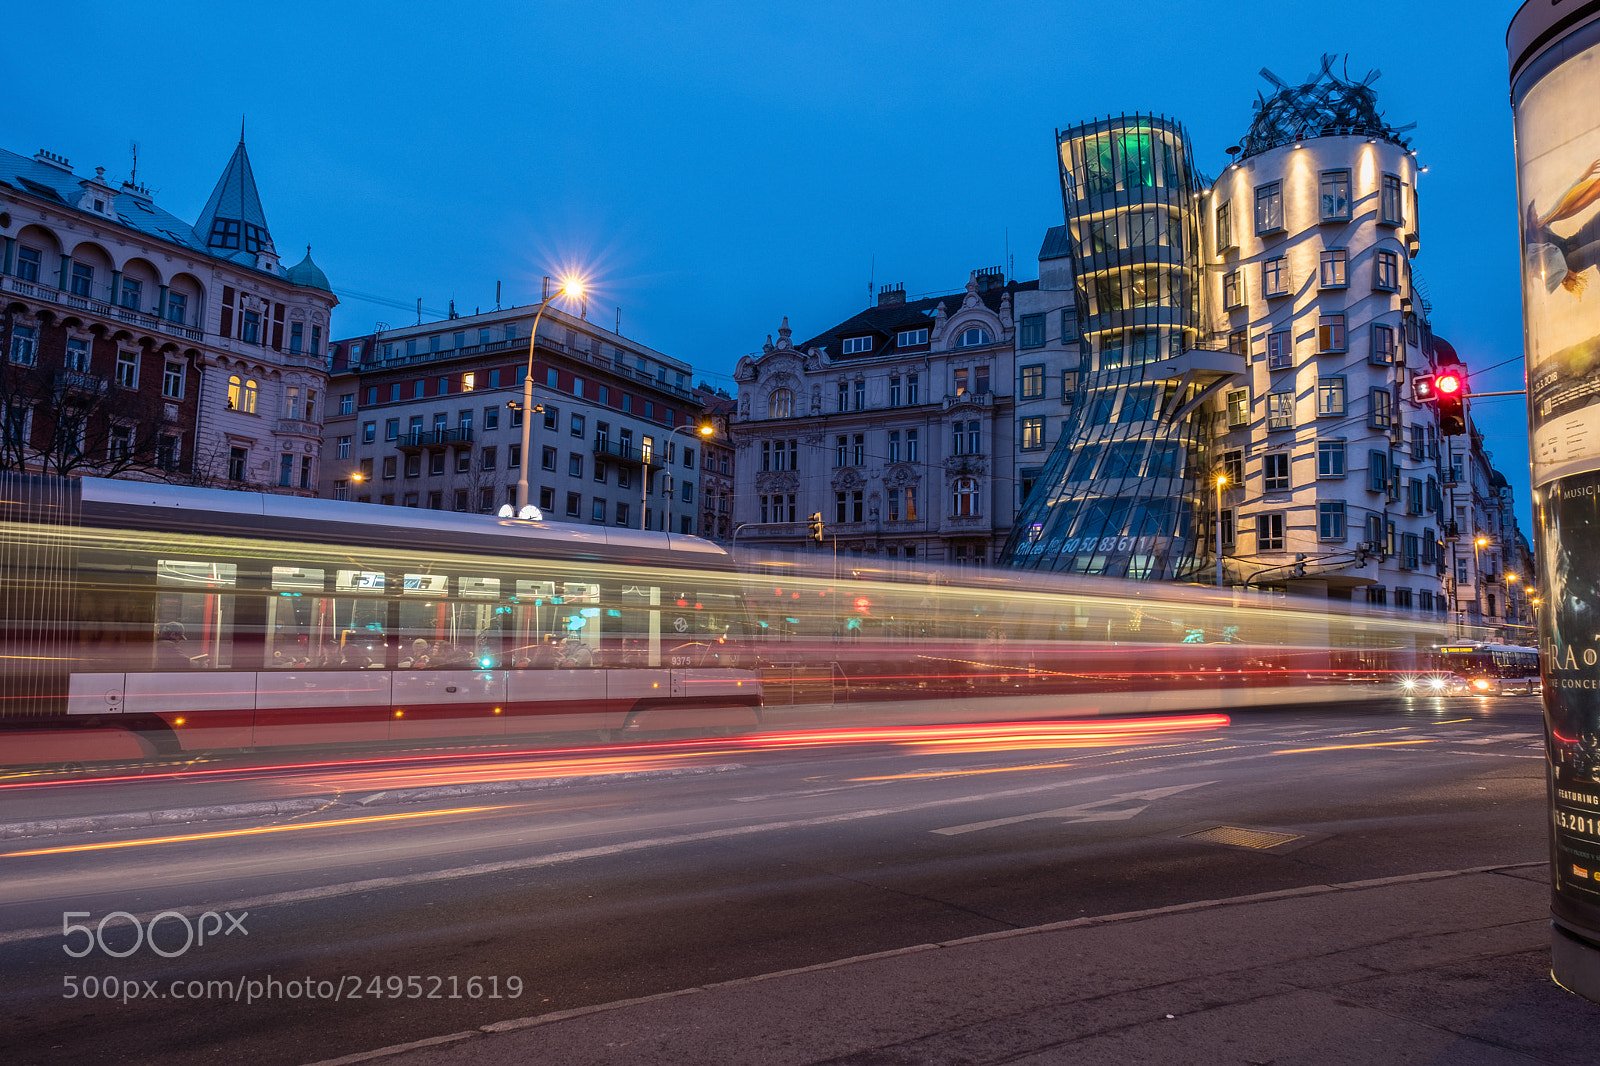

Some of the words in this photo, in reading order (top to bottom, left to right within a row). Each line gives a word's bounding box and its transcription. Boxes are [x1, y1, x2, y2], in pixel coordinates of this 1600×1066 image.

[1564, 485, 1593, 500] MUSIC
[1062, 537, 1080, 554] 60
[1079, 537, 1098, 552] 50
[1099, 536, 1116, 552] 83
[671, 656, 691, 665] 9375
[1561, 678, 1600, 690] CONCE
[1558, 788, 1599, 805] FEATURING
